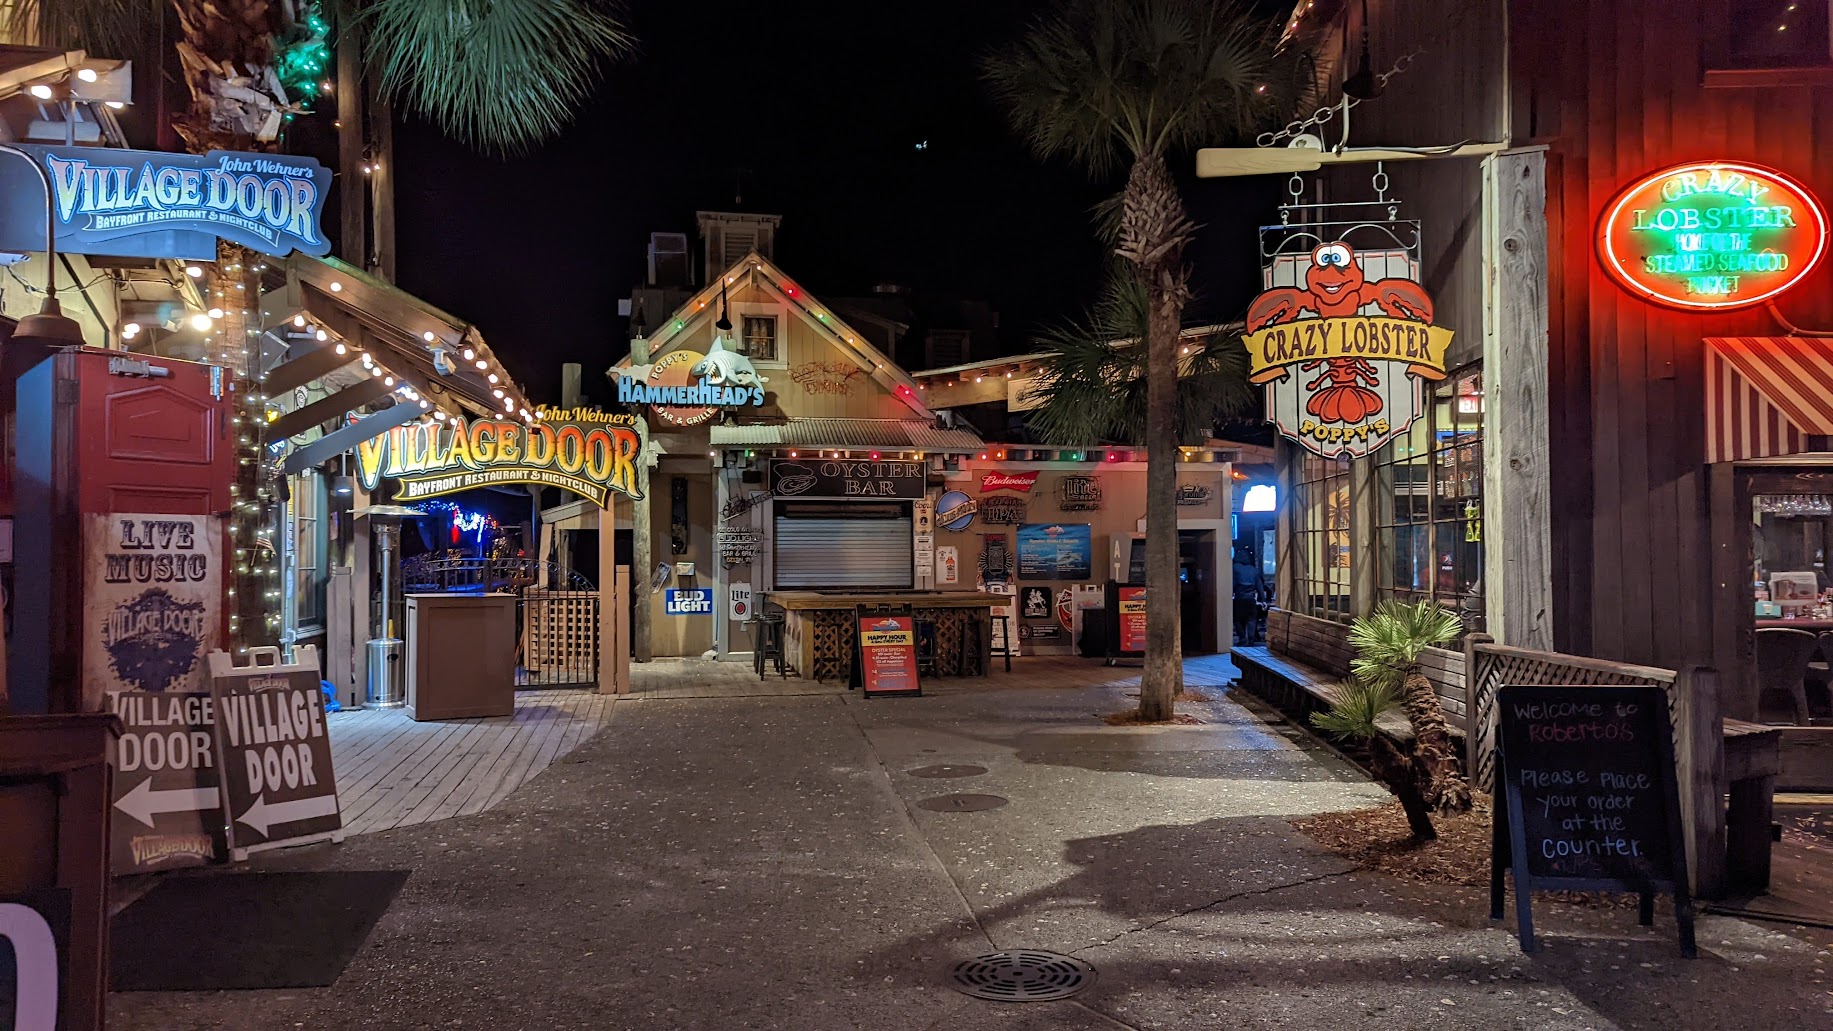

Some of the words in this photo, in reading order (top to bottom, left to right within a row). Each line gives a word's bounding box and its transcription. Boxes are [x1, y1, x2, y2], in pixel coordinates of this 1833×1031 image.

[215, 155, 252, 177] John
[253, 159, 314, 178] Wehner's
[47, 153, 202, 224] VILLAGE
[201, 167, 322, 245] DOOR
[1661, 168, 1769, 204] CRAZY
[95, 212, 145, 230] BAYFRONT
[147, 209, 207, 221] RESTAURANT
[208, 210, 218, 221] &
[218, 213, 274, 240] NIGHTCLUB
[1632, 206, 1797, 232] LOBSTER
[1646, 254, 1715, 273] STEAMED
[1719, 253, 1789, 272] SEAFOOD
[1263, 322, 1333, 364] CRAZY
[1341, 320, 1432, 362] LOBSTER
[651, 352, 689, 381] POPPY'S
[618, 375, 765, 407] HAMMERHEAD'S
[534, 404, 572, 424] John
[572, 408, 637, 426] Wehner's
[657, 406, 674, 424] BAR
[676, 416, 683, 425] &
[686, 407, 714, 426] GRILLE
[1300, 418, 1390, 444] POPPY'S
[345, 411, 521, 490] VILLAGE
[520, 420, 645, 501] DOOR
[820, 462, 922, 478] OYSTER
[982, 475, 1036, 486] Budweiser
[408, 475, 463, 497] BAYFRONT
[465, 470, 530, 485] RESTAURANT
[530, 470, 541, 480] &
[541, 473, 598, 499] NIGHTCLUB
[844, 480, 896, 496] BAR
[120, 520, 195, 549] LIVE
[104, 553, 206, 584] MUSIC
[667, 601, 711, 612] LIGHT
[673, 590, 705, 602] BUD
[731, 590, 750, 602] Lite
[108, 607, 162, 647] VILLAGE
[163, 609, 204, 641] DOOR
[113, 696, 215, 727] VILLAGE
[221, 689, 323, 747] VILLAGE
[1514, 702, 1602, 720] Welcome
[1615, 702, 1638, 717] to
[119, 731, 213, 772] DOOR
[245, 743, 317, 794] DOOR
[1521, 768, 1590, 789] Please
[1536, 794, 1577, 819] your
[1588, 794, 1637, 810] order
[1562, 814, 1586, 832] at
[1590, 813, 1626, 832] the
[131, 836, 179, 866] VILLAGE
